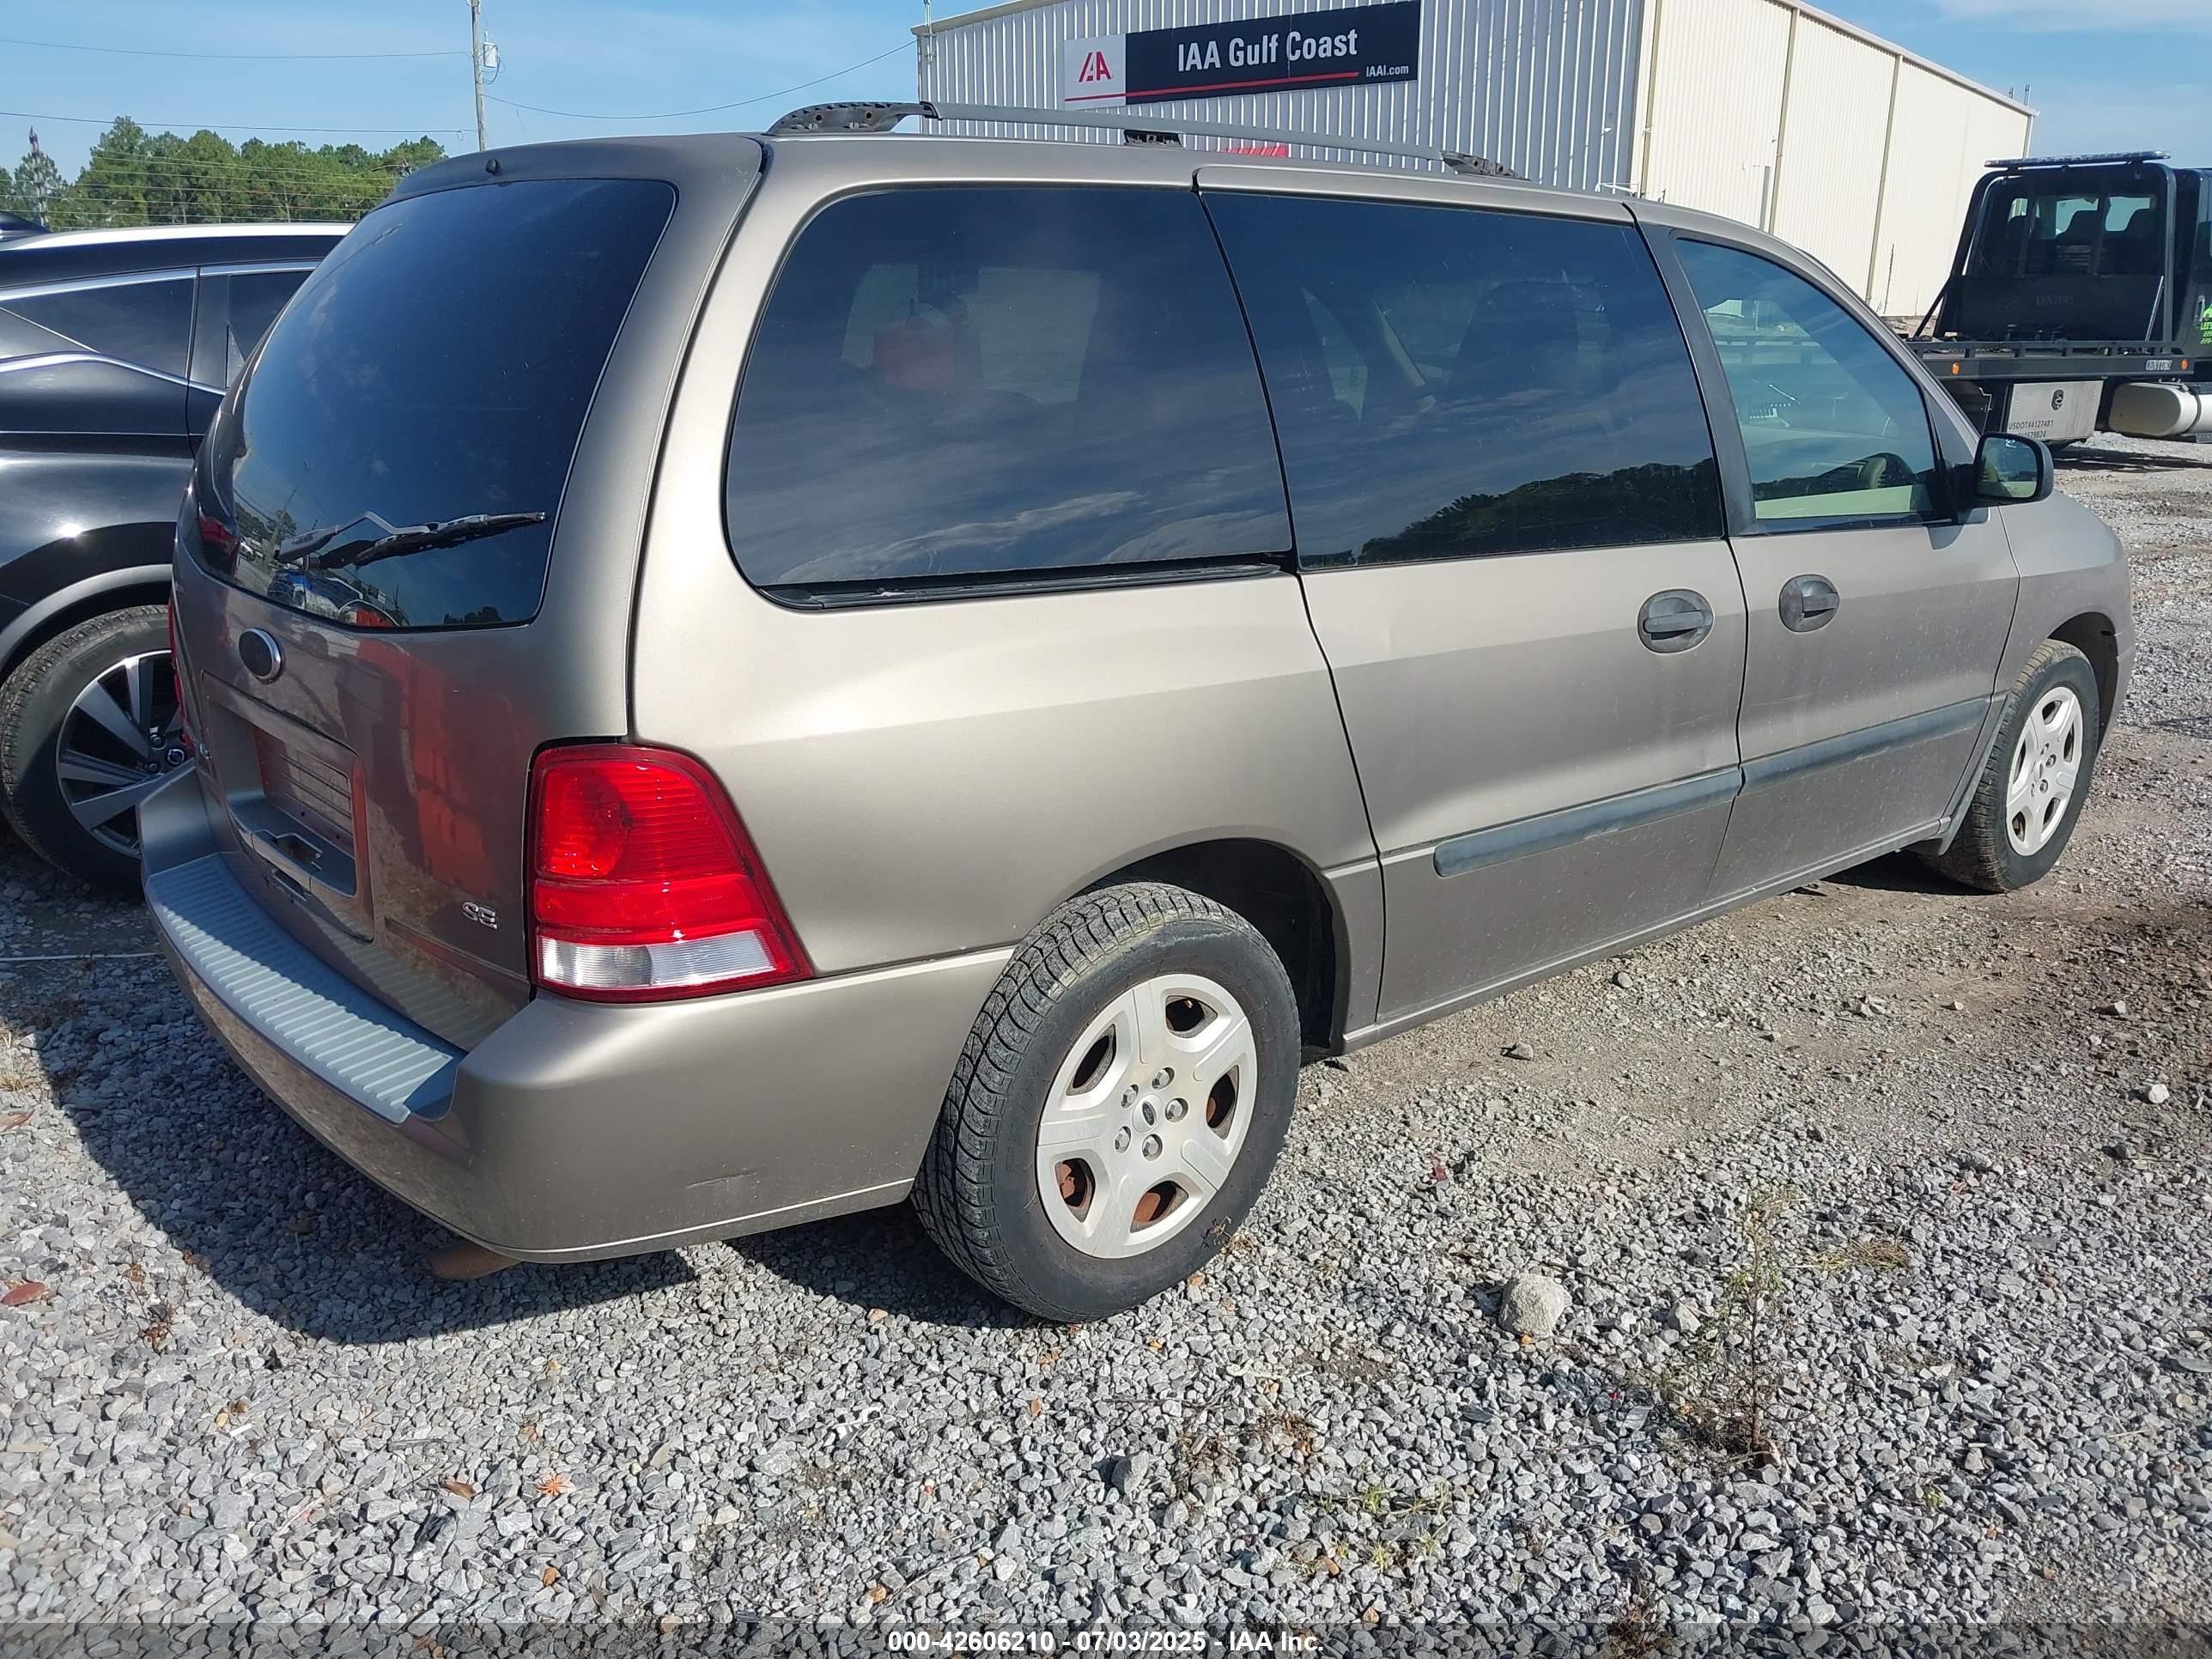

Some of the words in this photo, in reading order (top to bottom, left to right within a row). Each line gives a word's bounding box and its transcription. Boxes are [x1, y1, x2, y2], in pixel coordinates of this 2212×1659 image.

[1177, 40, 1221, 72] IAA
[1228, 33, 1279, 68] Gulf
[1285, 27, 1358, 62] Coast
[1366, 64, 1409, 77] IAAI.com
[462, 902, 498, 929] SE
